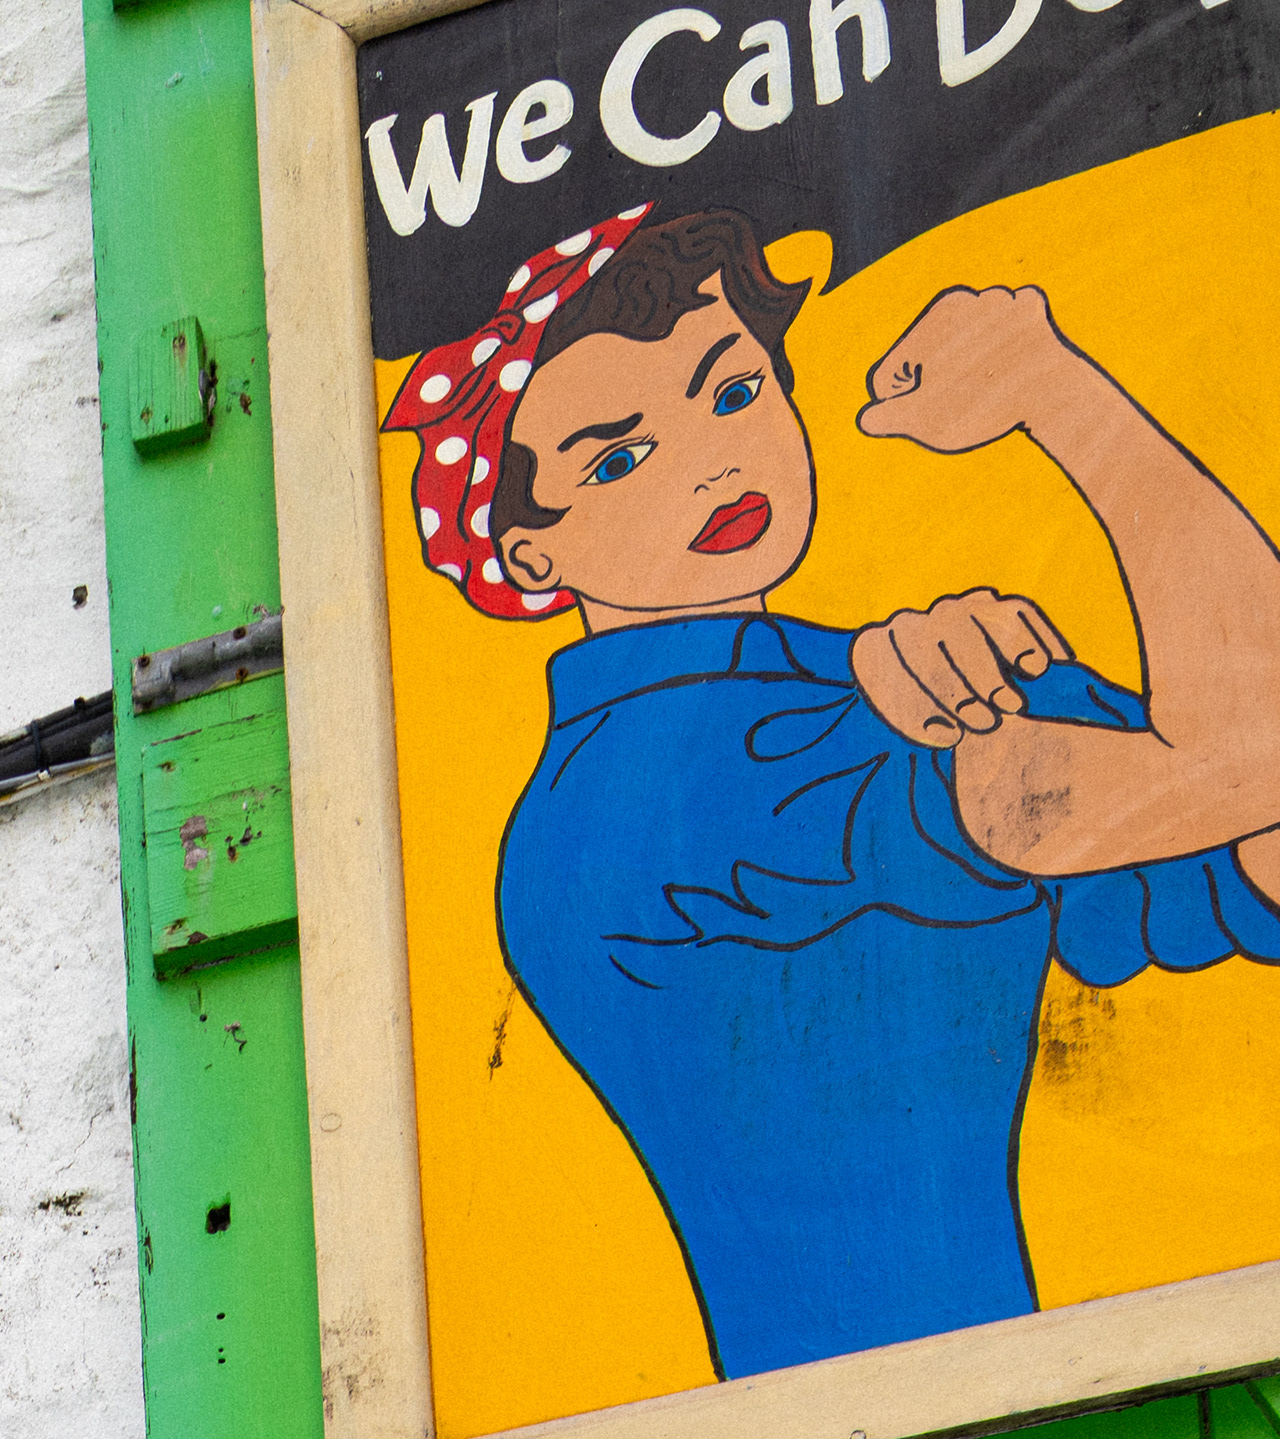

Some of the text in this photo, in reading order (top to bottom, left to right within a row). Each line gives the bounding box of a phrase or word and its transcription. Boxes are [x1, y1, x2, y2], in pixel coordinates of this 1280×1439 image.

[365, 0, 1124, 236] We Can D
